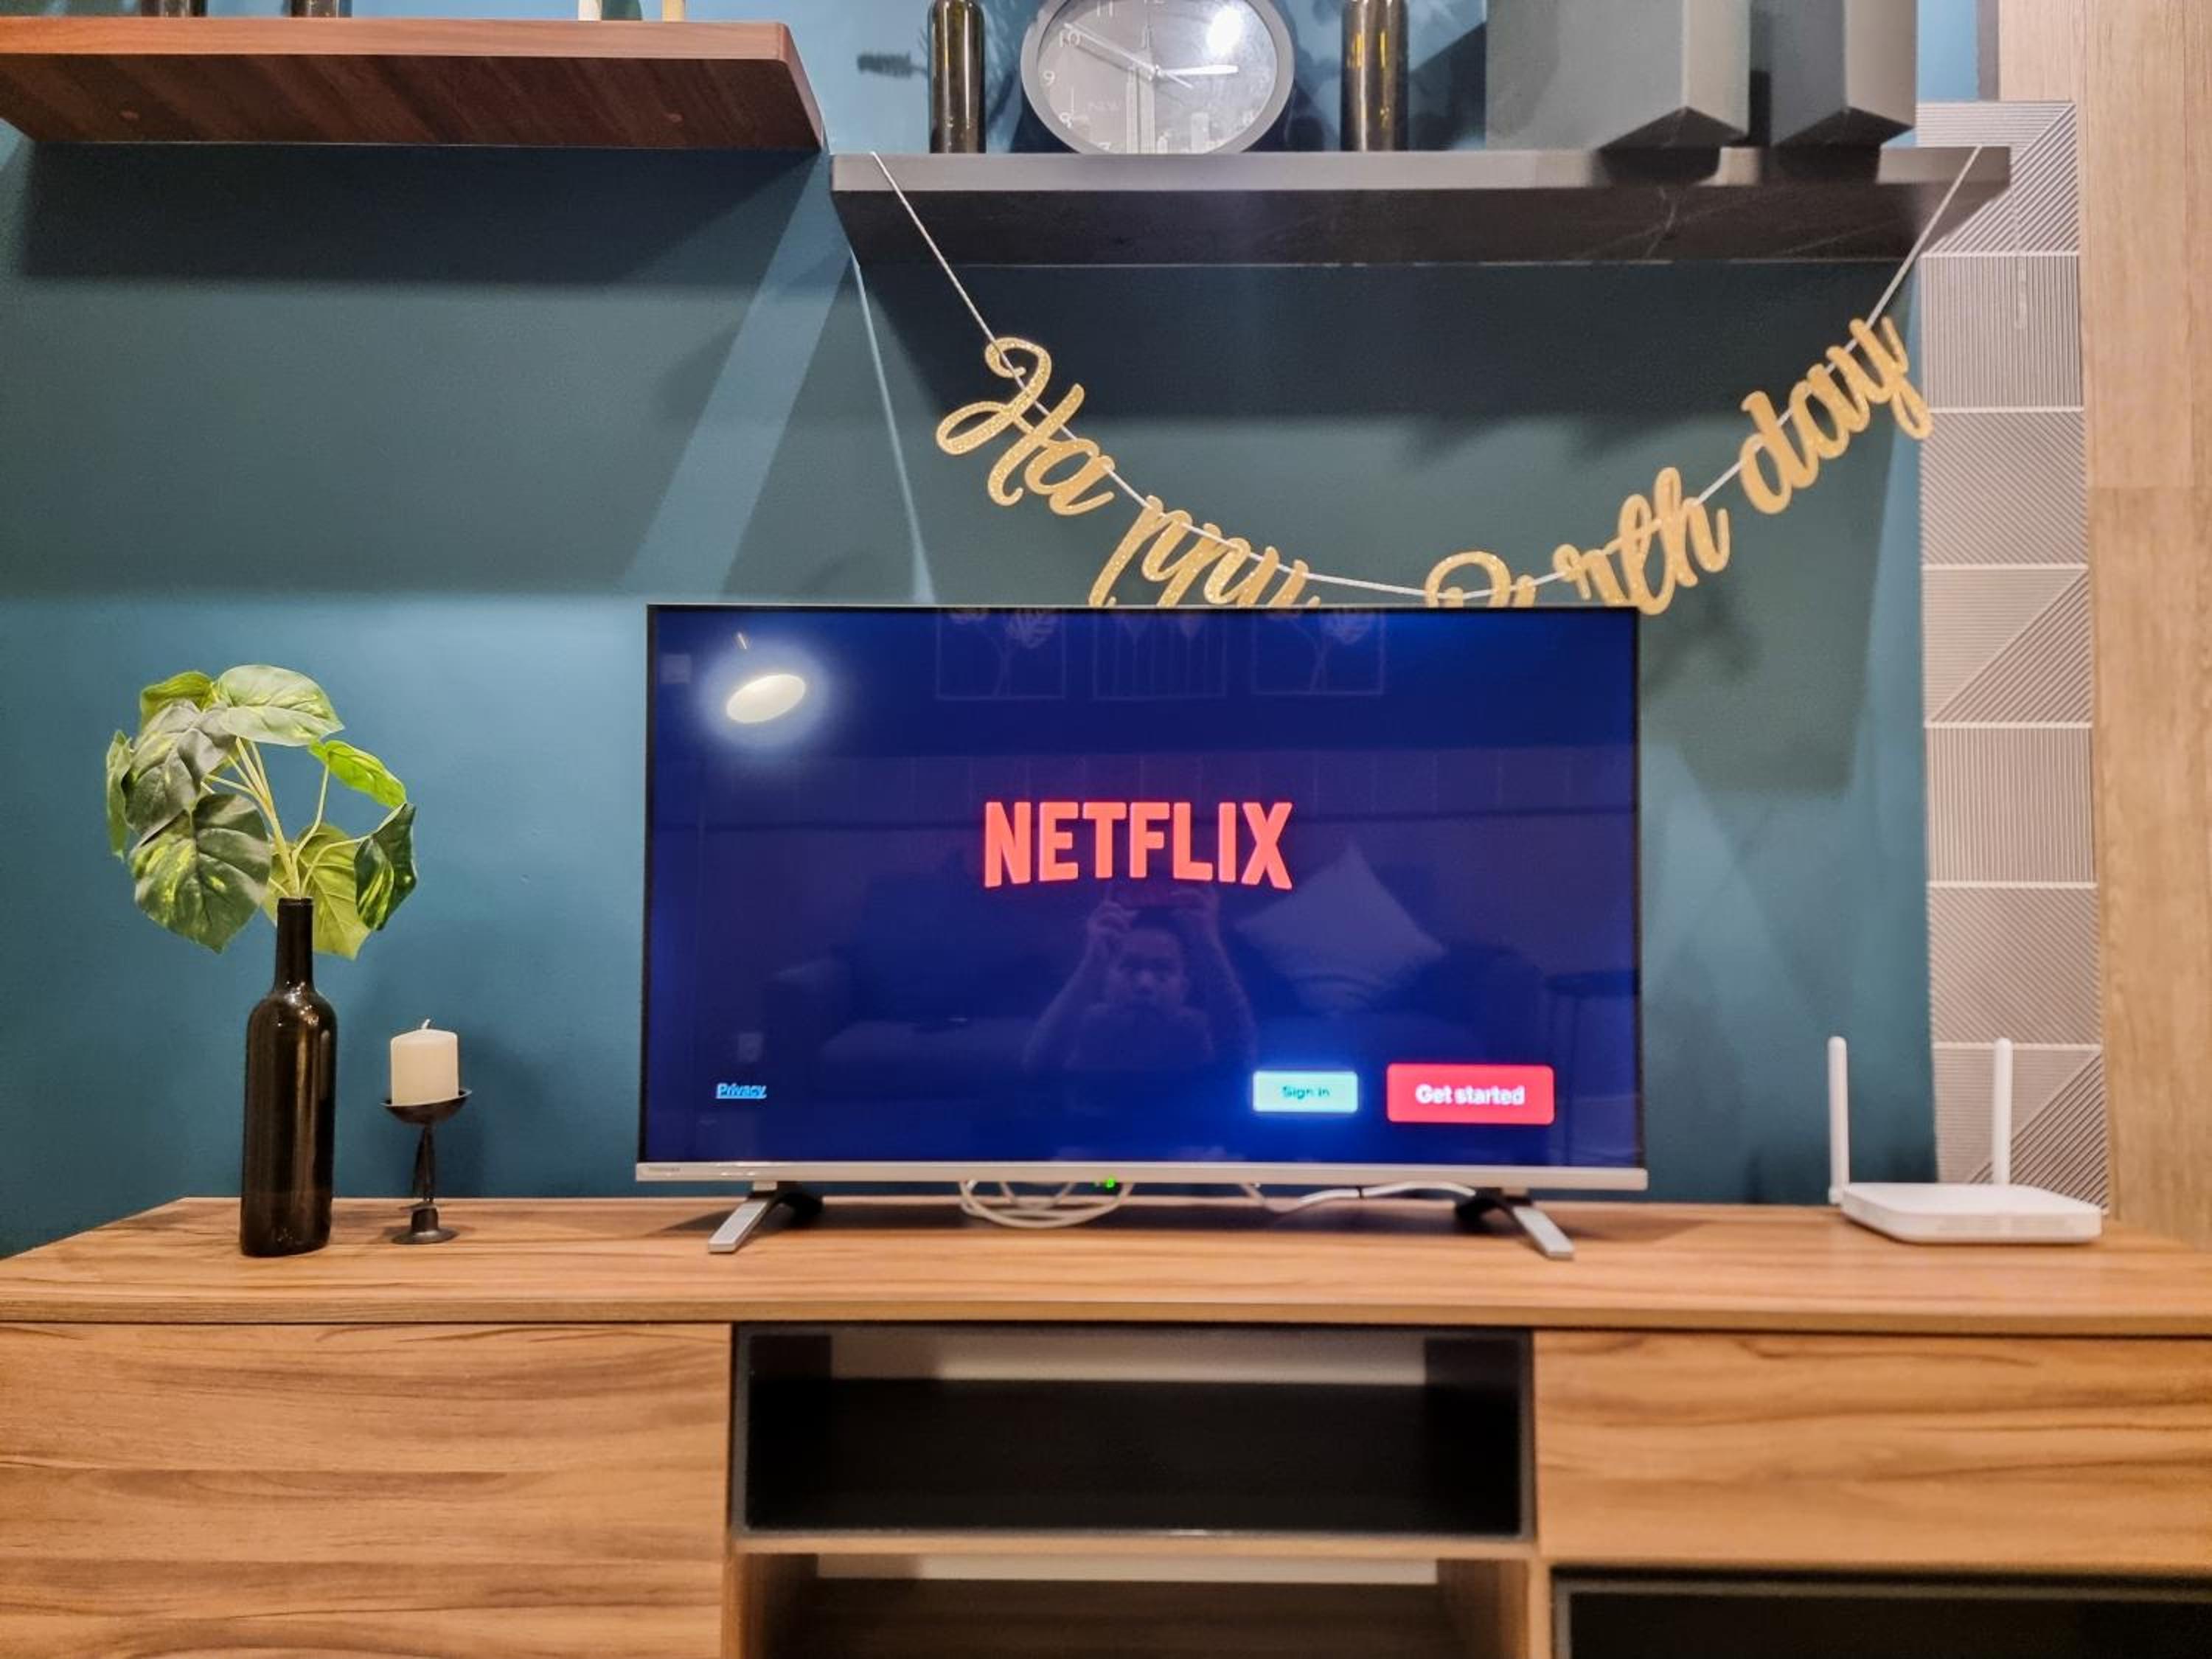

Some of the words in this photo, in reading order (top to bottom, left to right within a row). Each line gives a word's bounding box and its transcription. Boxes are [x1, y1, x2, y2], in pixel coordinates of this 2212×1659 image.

[1043, 70, 1056, 86] 9
[984, 801, 1293, 891] NETFLIX
[716, 1082, 768, 1099] Privacy
[1282, 1085, 1314, 1099] Sign
[1318, 1086, 1330, 1097] in
[1415, 1082, 1453, 1105] Get
[1454, 1084, 1526, 1106] started
